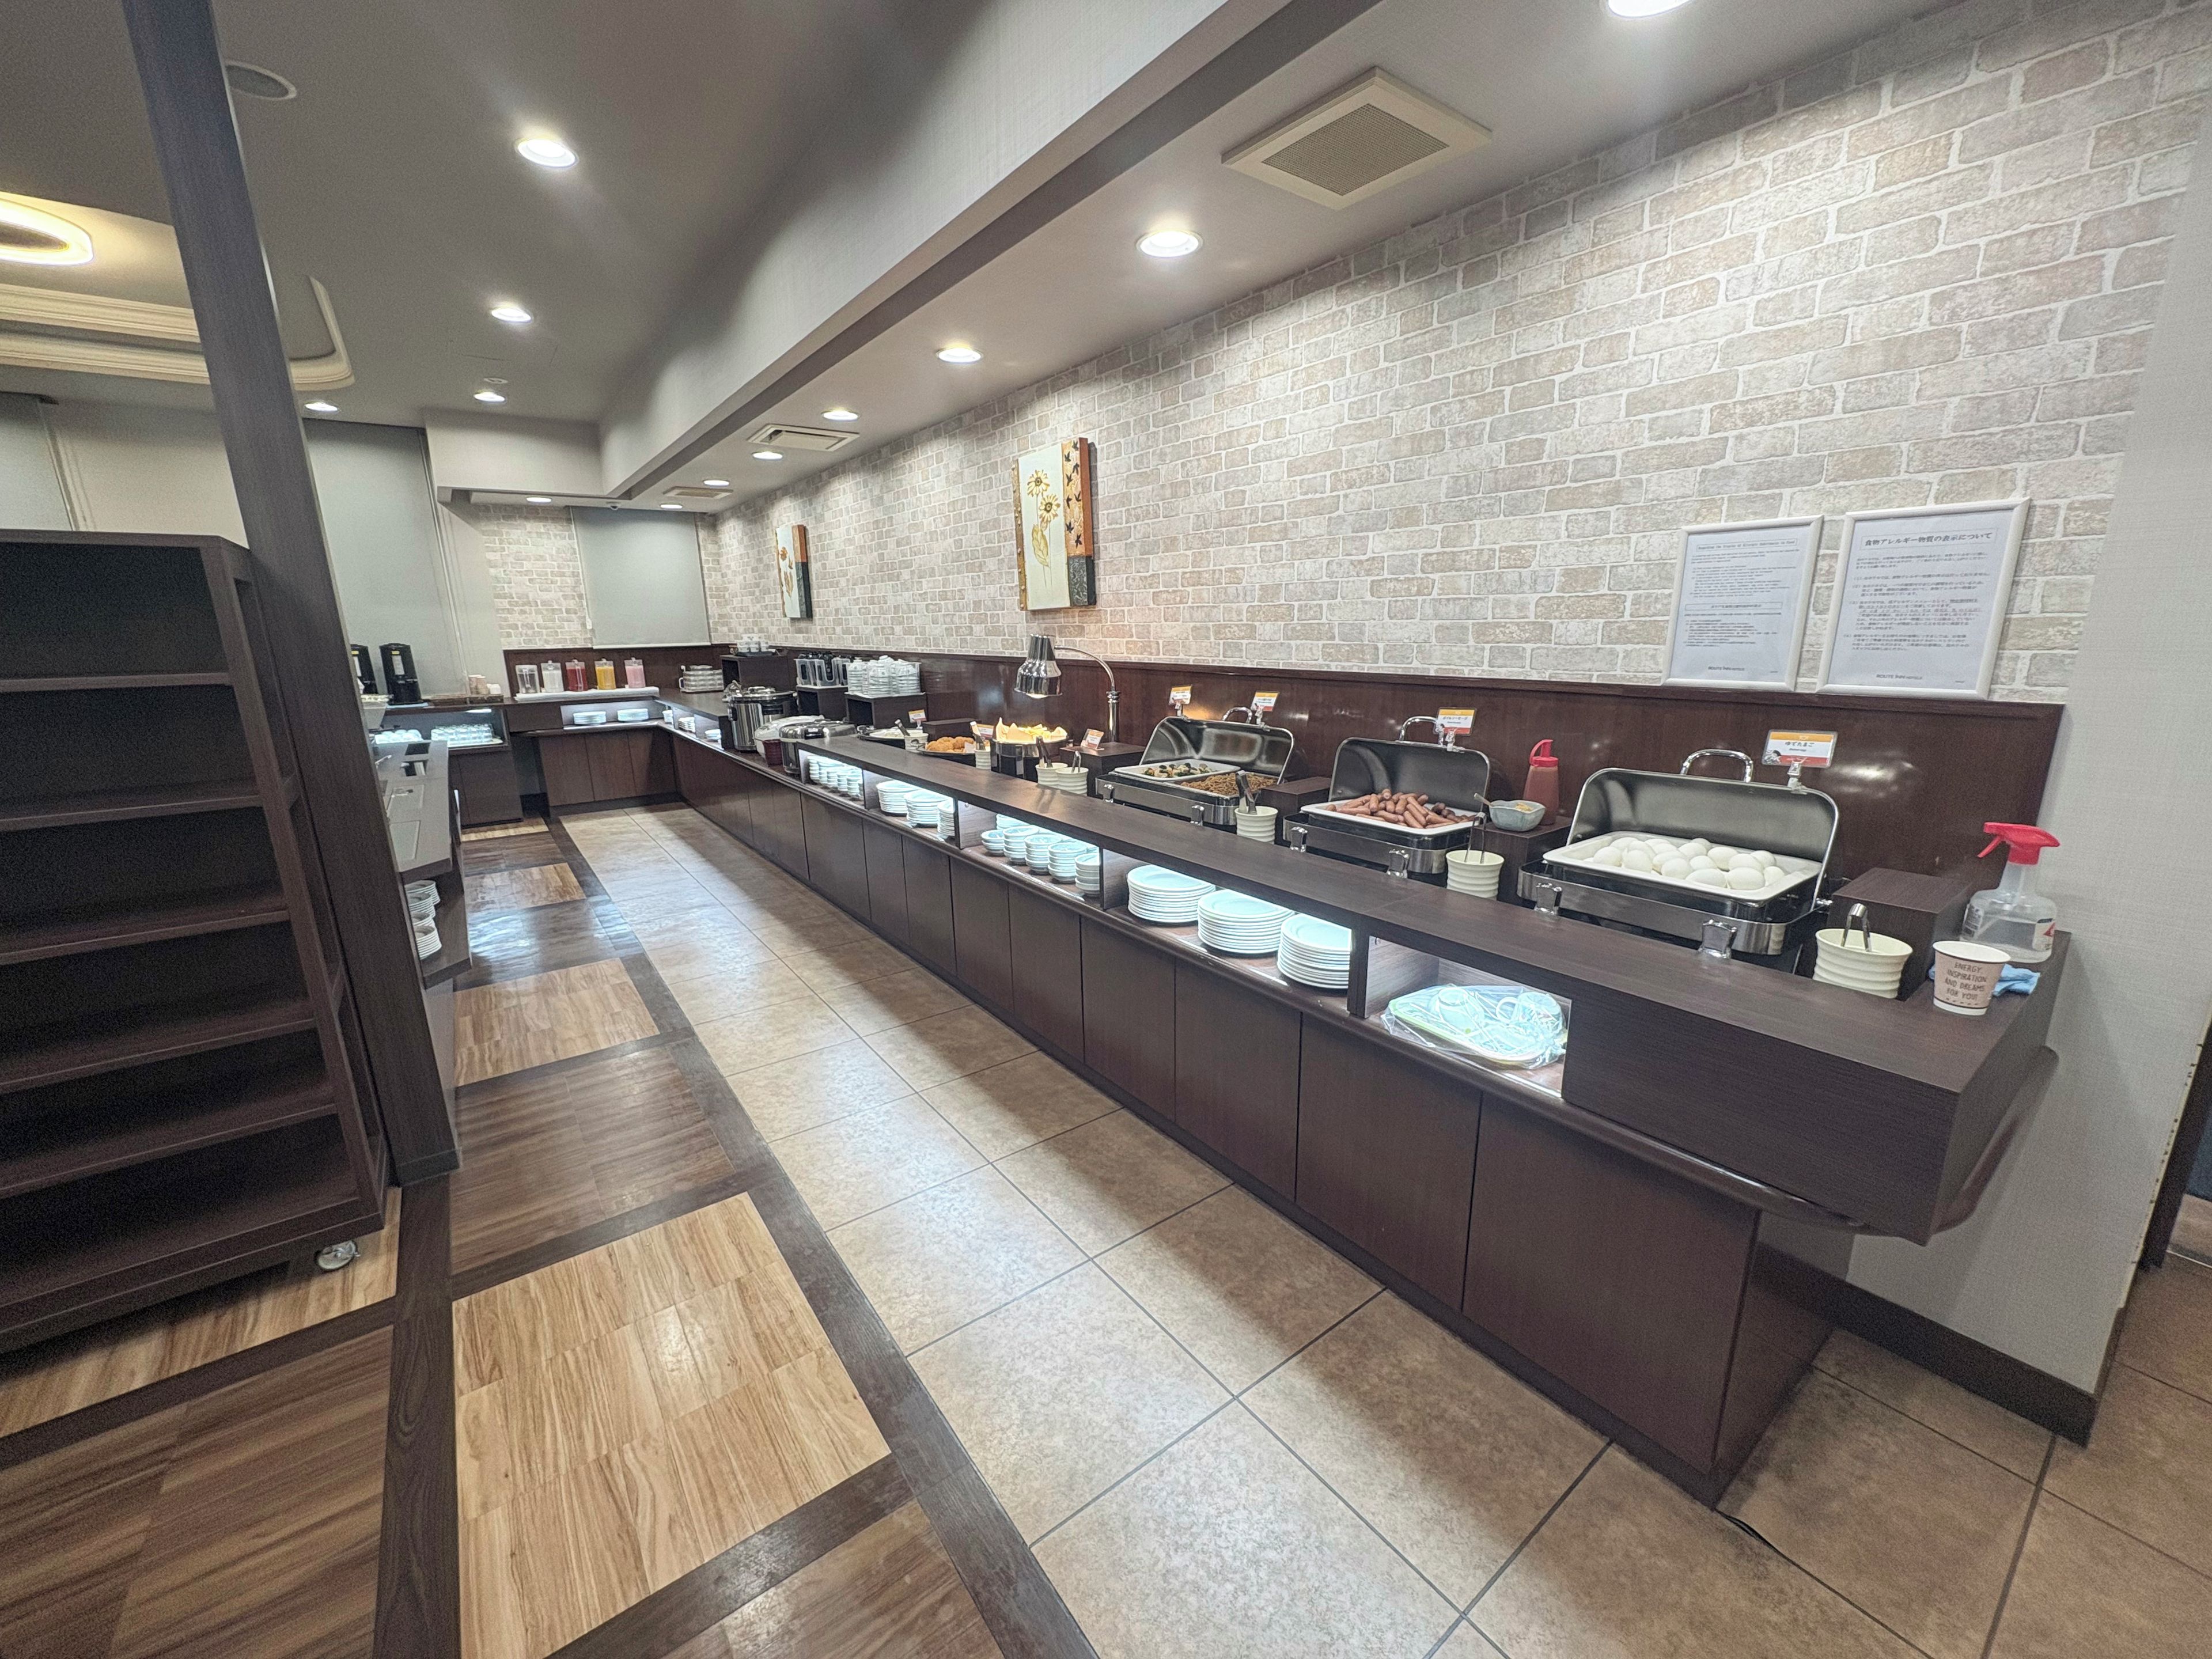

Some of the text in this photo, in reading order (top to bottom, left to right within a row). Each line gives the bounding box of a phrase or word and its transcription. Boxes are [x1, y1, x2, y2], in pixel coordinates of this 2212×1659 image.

[1865, 532, 1993, 546] 食物アレルギー物質の表示について
[1954, 962, 1982, 973] ENERGY
[1947, 969, 1987, 983] INSPIRATION
[1945, 977, 1984, 992] AND DREAMS
[1946, 988, 1958, 997] FOR
